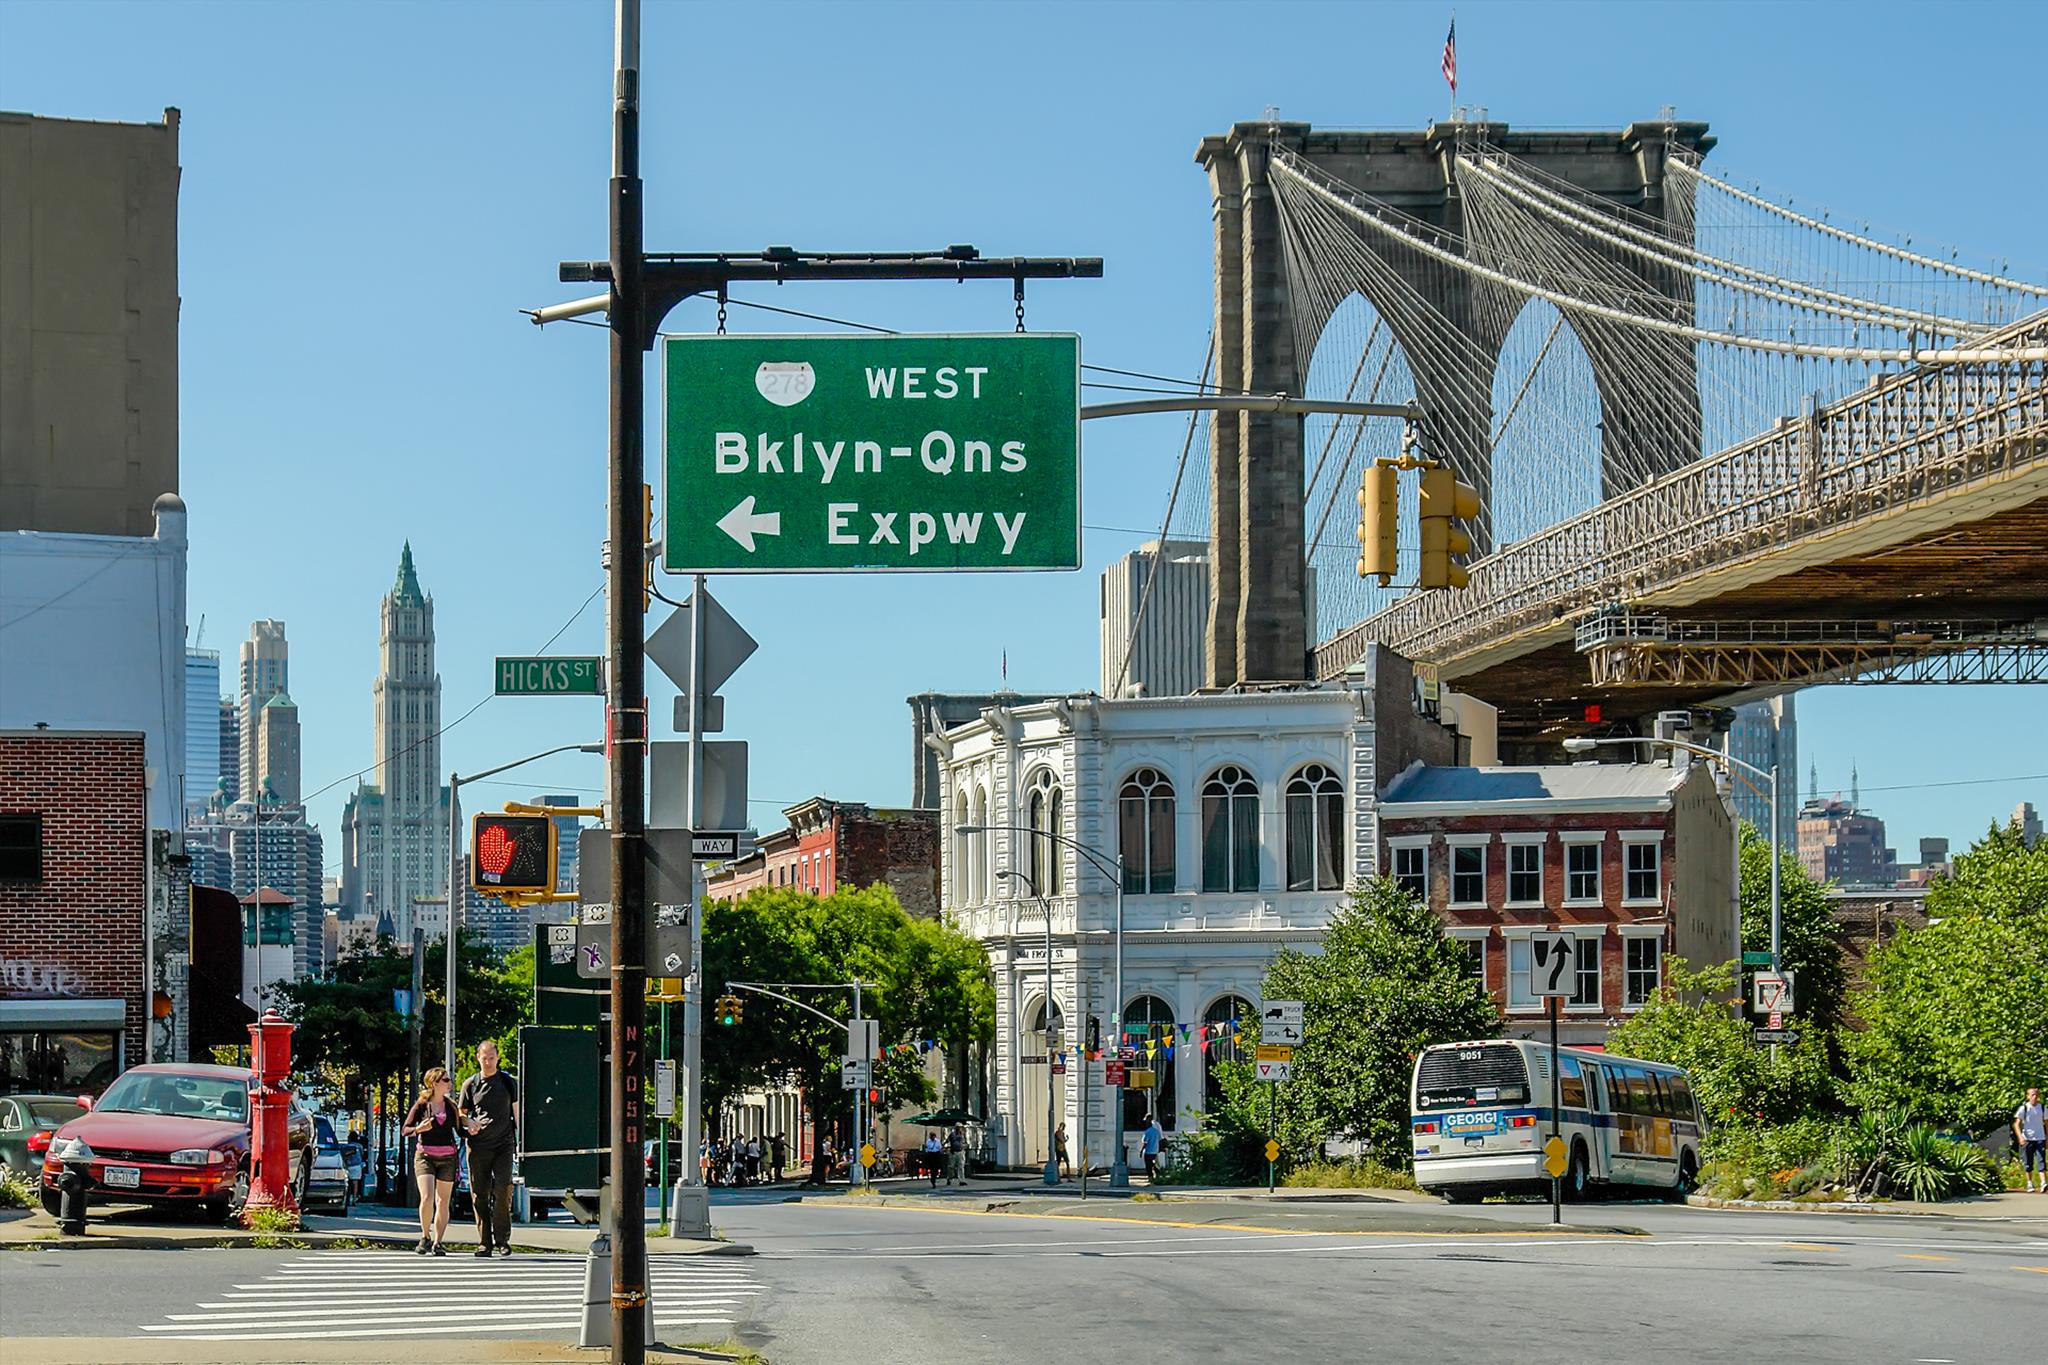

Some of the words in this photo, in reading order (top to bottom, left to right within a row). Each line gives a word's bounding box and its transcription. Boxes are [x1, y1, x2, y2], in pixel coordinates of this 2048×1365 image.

[763, 373, 809, 395] 278
[865, 367, 988, 399] WEST
[715, 430, 1027, 484] Bklyn-Qns
[828, 503, 1026, 556] Expwy
[502, 662, 569, 690] HICKS
[574, 662, 592, 677] ST
[702, 840, 727, 851] WAY
[1460, 1051, 1482, 1060] 9051
